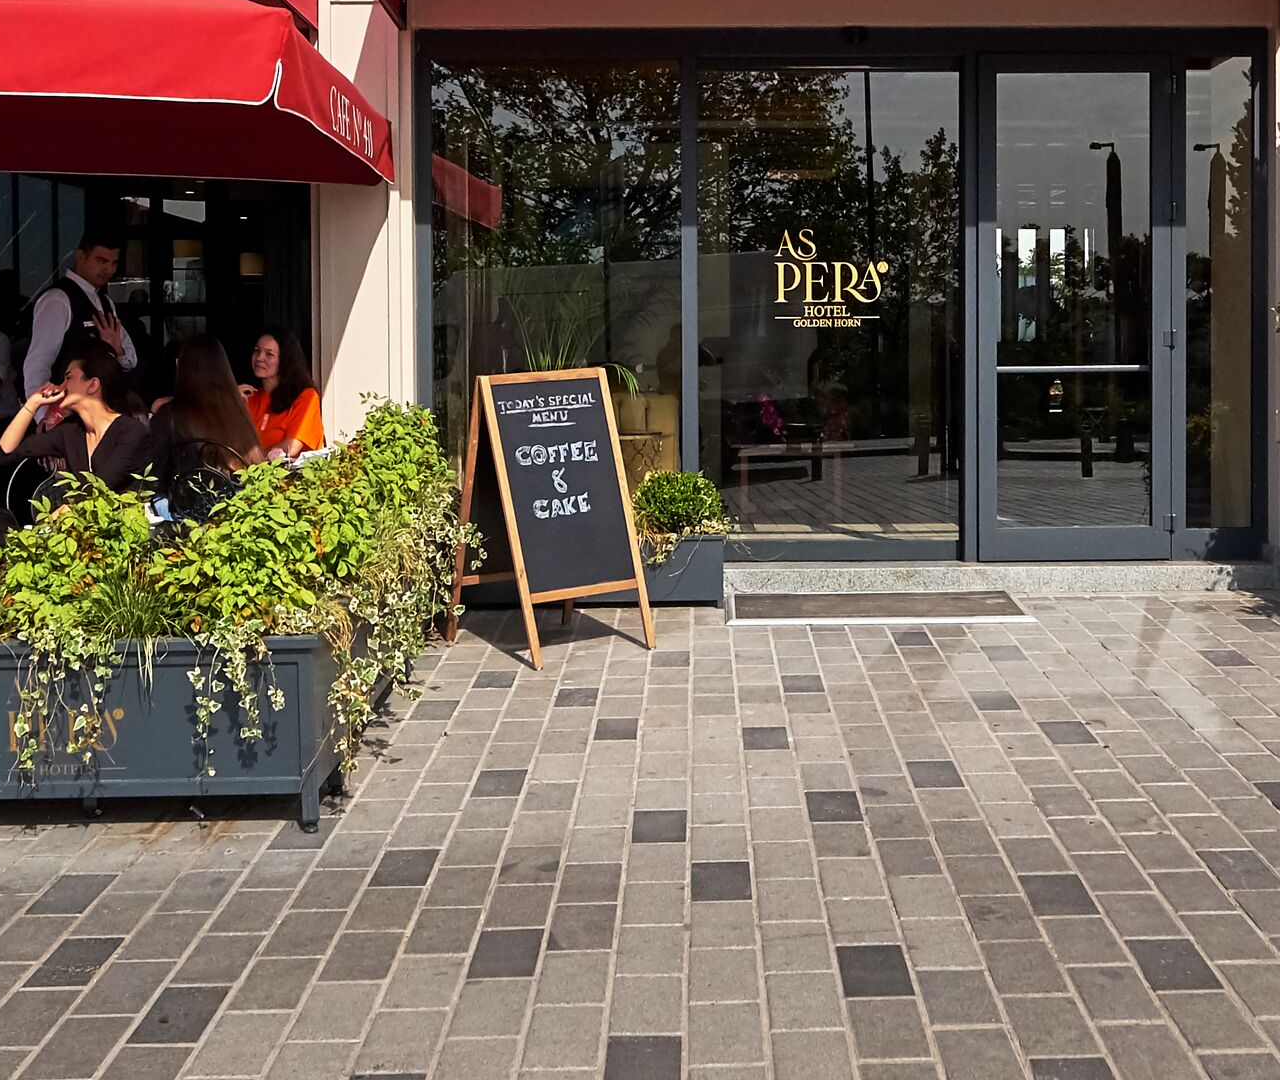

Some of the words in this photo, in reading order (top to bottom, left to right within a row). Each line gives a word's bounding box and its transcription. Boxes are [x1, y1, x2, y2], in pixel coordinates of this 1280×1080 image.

[329, 85, 351, 141] CAFE
[773, 228, 818, 261] AS
[773, 260, 882, 303] PERA
[793, 318, 832, 328] GOLDEN
[834, 318, 861, 328] HORN
[803, 305, 851, 318] HOTEL
[497, 395, 546, 414] TODAY'S
[548, 391, 597, 407] SPECIAL
[531, 409, 569, 424] MENU
[514, 439, 599, 466] COFFEE
[532, 491, 592, 519] CAKE
